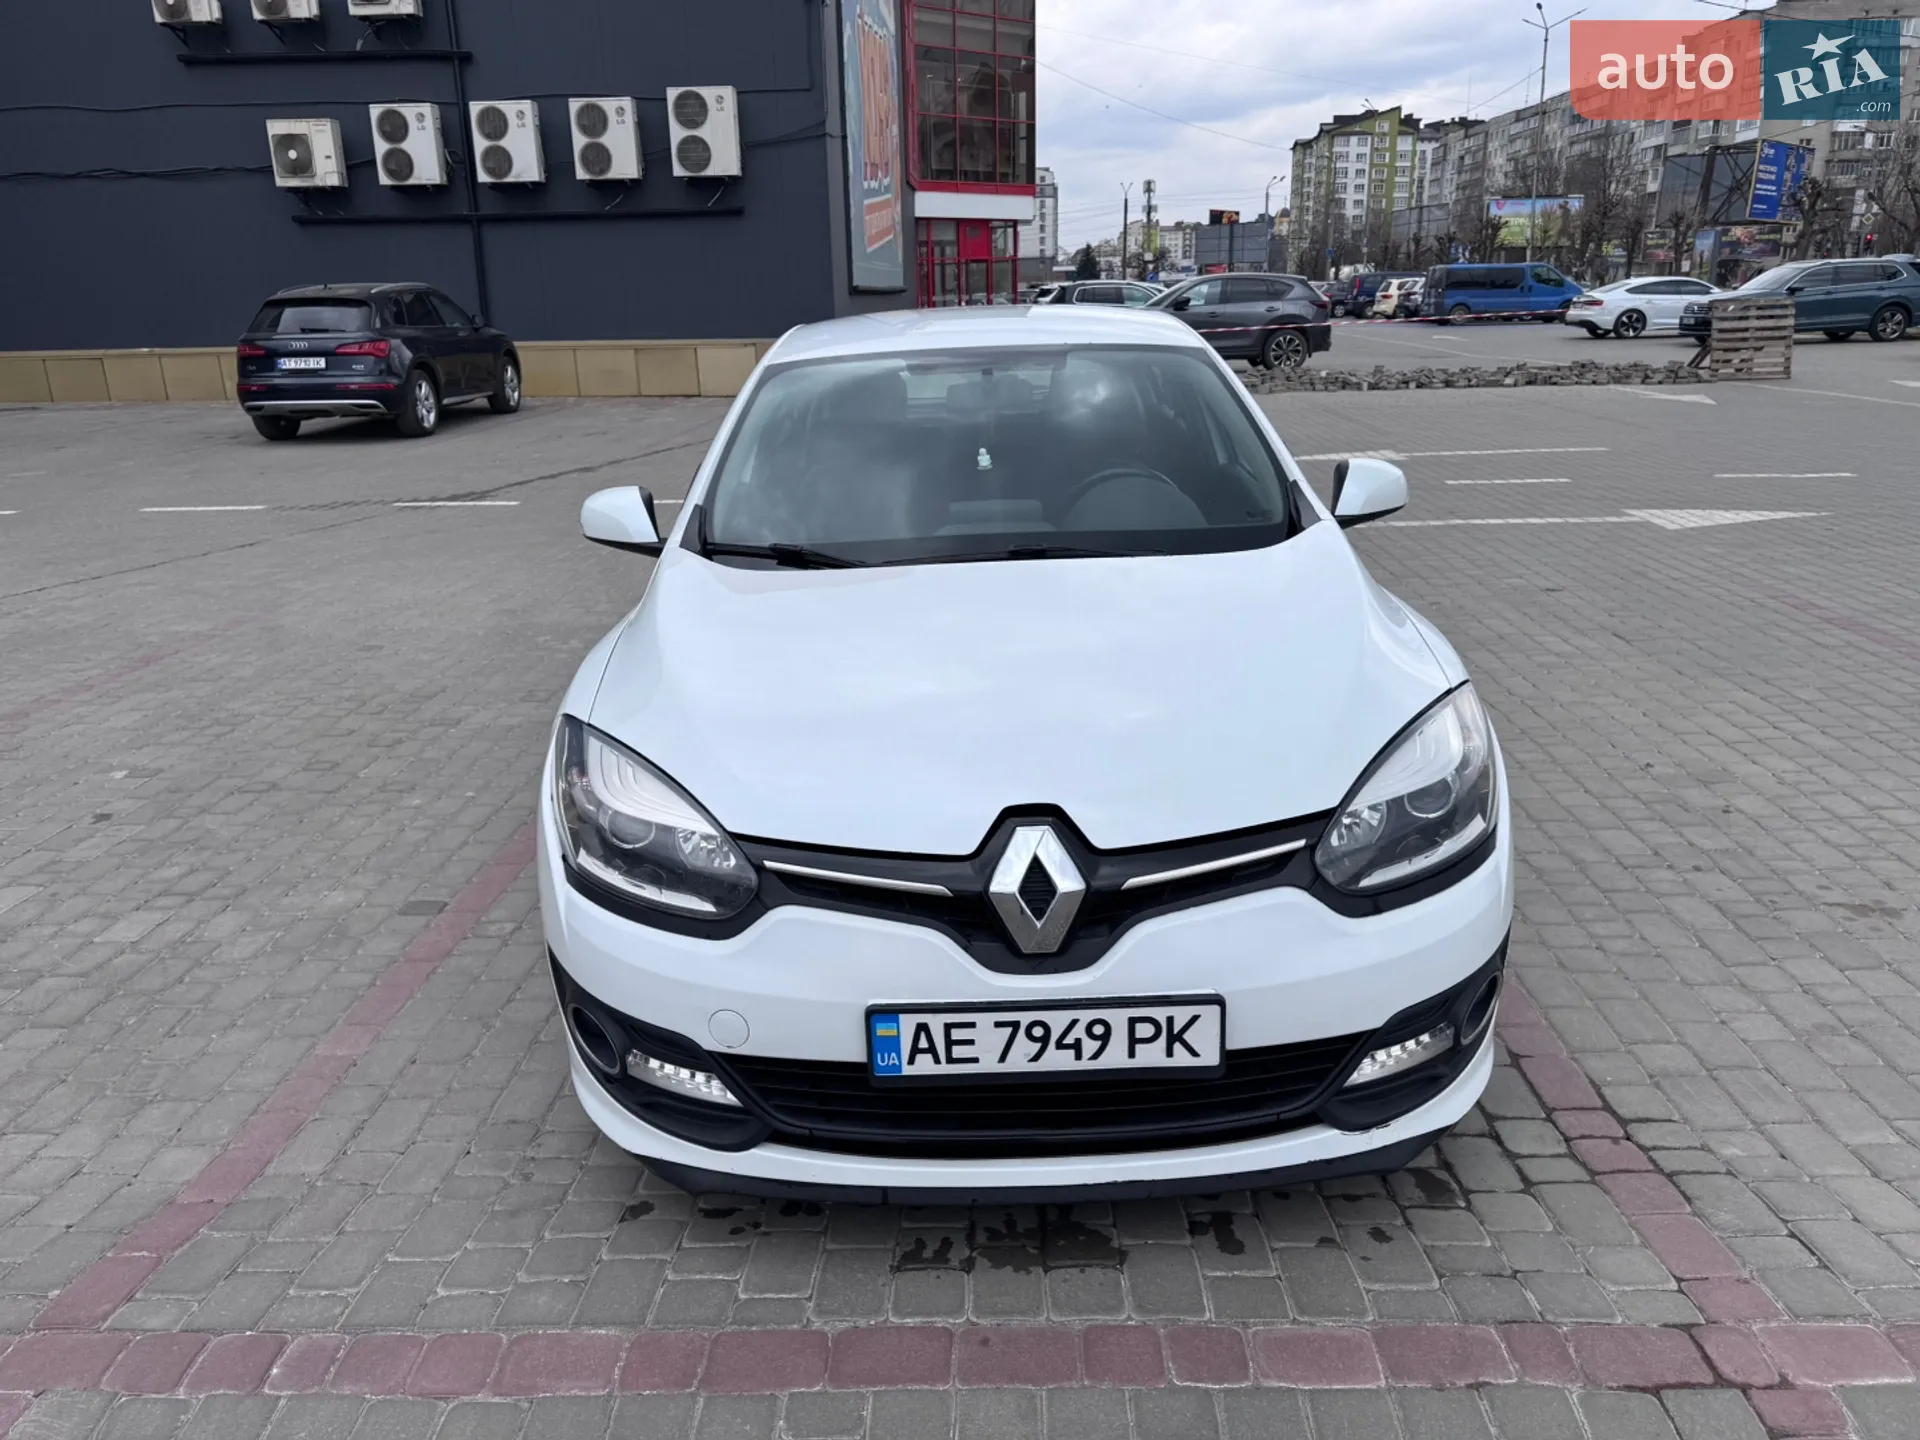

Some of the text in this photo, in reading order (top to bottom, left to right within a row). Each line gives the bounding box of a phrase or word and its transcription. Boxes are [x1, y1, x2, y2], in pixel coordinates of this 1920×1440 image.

[907, 1014, 1202, 1066] AE 7949 PK
[877, 1053, 900, 1066] UA
